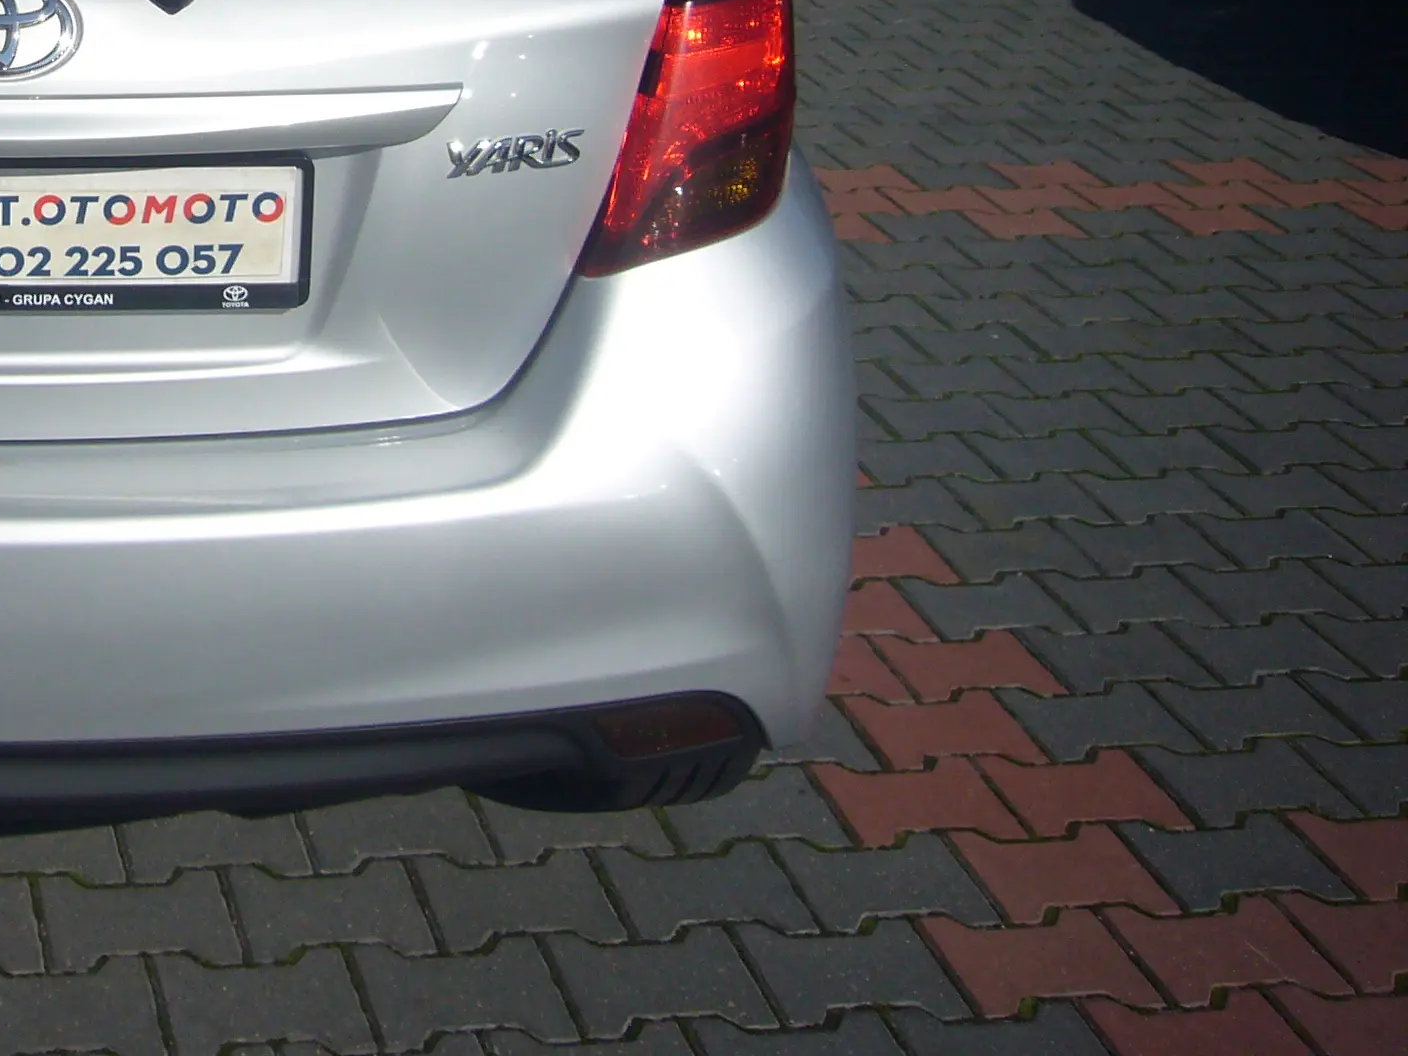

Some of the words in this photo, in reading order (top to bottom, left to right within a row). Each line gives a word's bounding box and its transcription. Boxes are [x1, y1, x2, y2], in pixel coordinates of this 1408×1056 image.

[446, 128, 585, 179] YARIS
[64, 245, 143, 277] 225
[155, 244, 244, 276] 057
[12, 293, 61, 305] GRUPA
[64, 293, 113, 305] CYGAN
